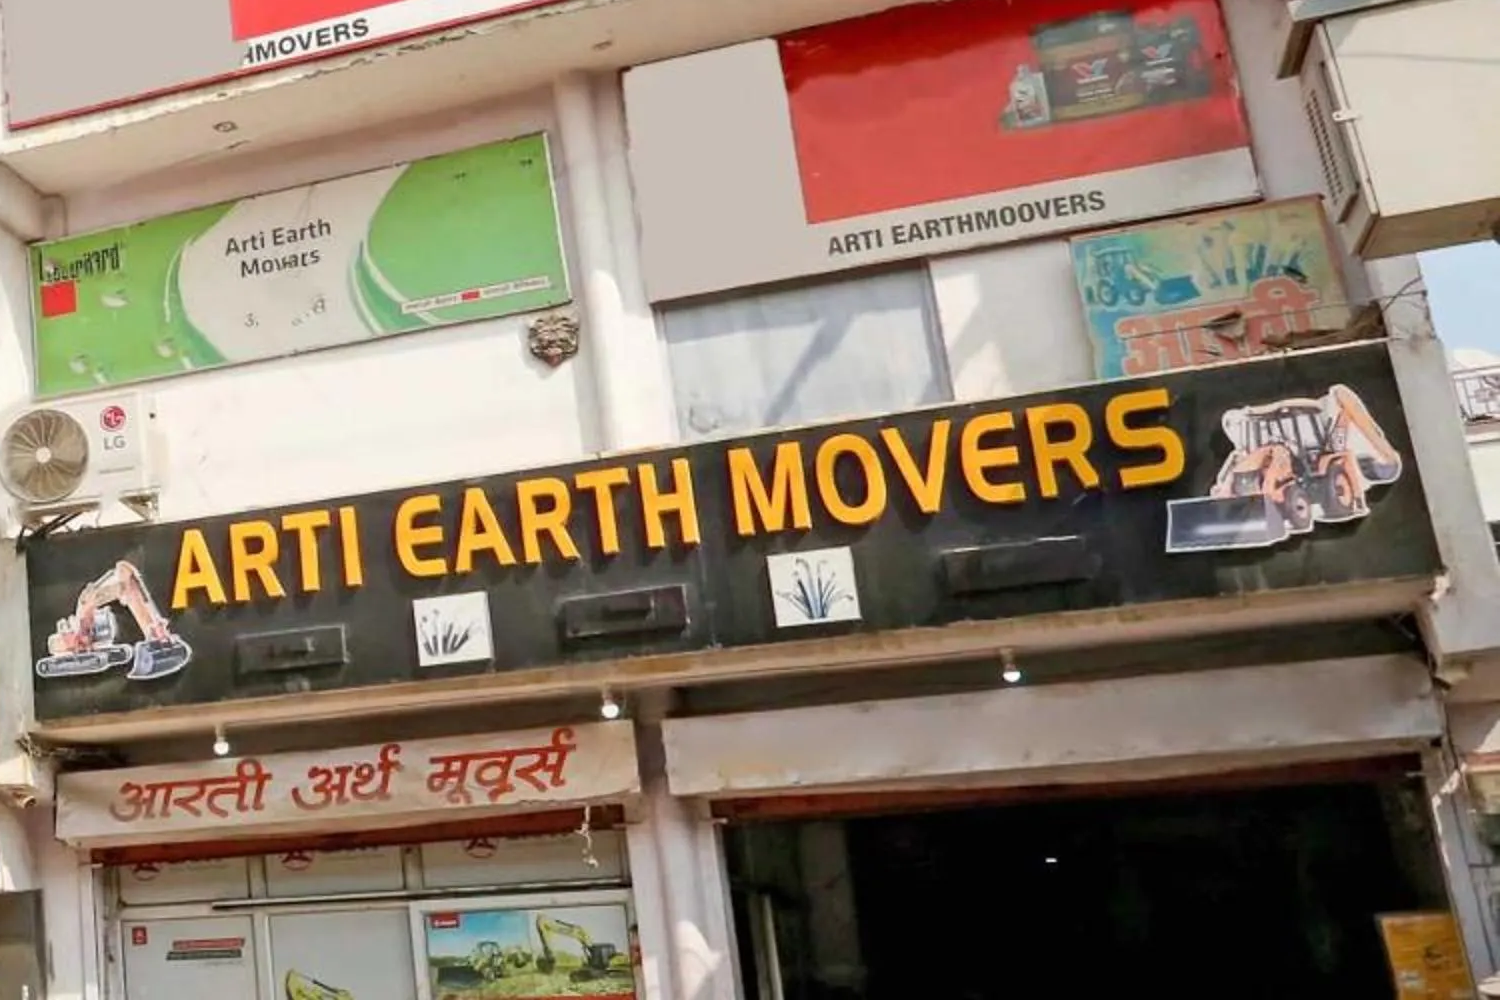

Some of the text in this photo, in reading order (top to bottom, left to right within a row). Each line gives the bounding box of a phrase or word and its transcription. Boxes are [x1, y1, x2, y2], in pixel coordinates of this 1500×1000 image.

[225, 218, 331, 257] Arti Earth
[828, 190, 1107, 257] ARTI EARTHMOOVERS
[103, 435, 126, 451] LG
[171, 387, 1187, 610] ARTI EARTH MOVERS
[108, 727, 578, 824] आरती अर्थ मूवर्स
